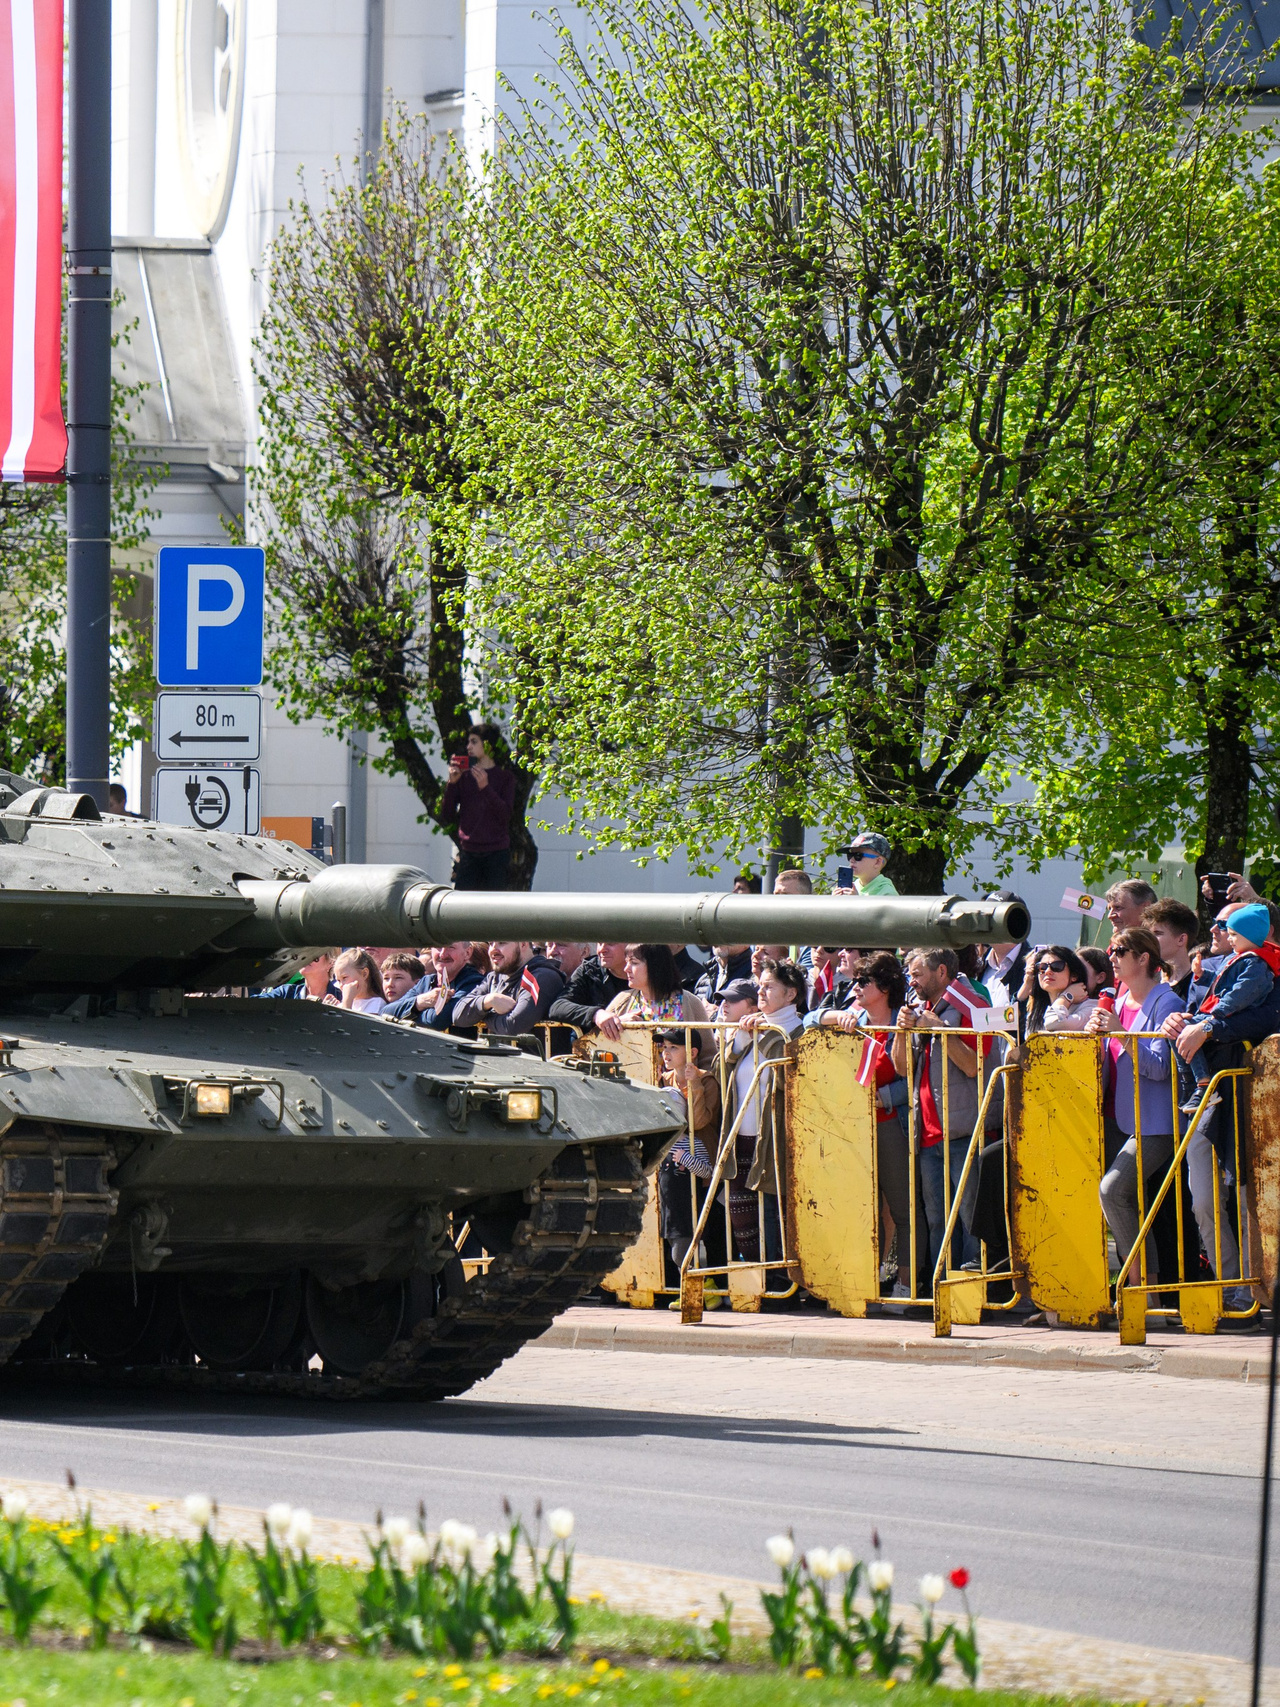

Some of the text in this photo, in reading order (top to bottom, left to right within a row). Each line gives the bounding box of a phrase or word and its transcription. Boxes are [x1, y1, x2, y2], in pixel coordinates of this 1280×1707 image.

[186, 564, 245, 670] P
[196, 704, 235, 727] 80 m
